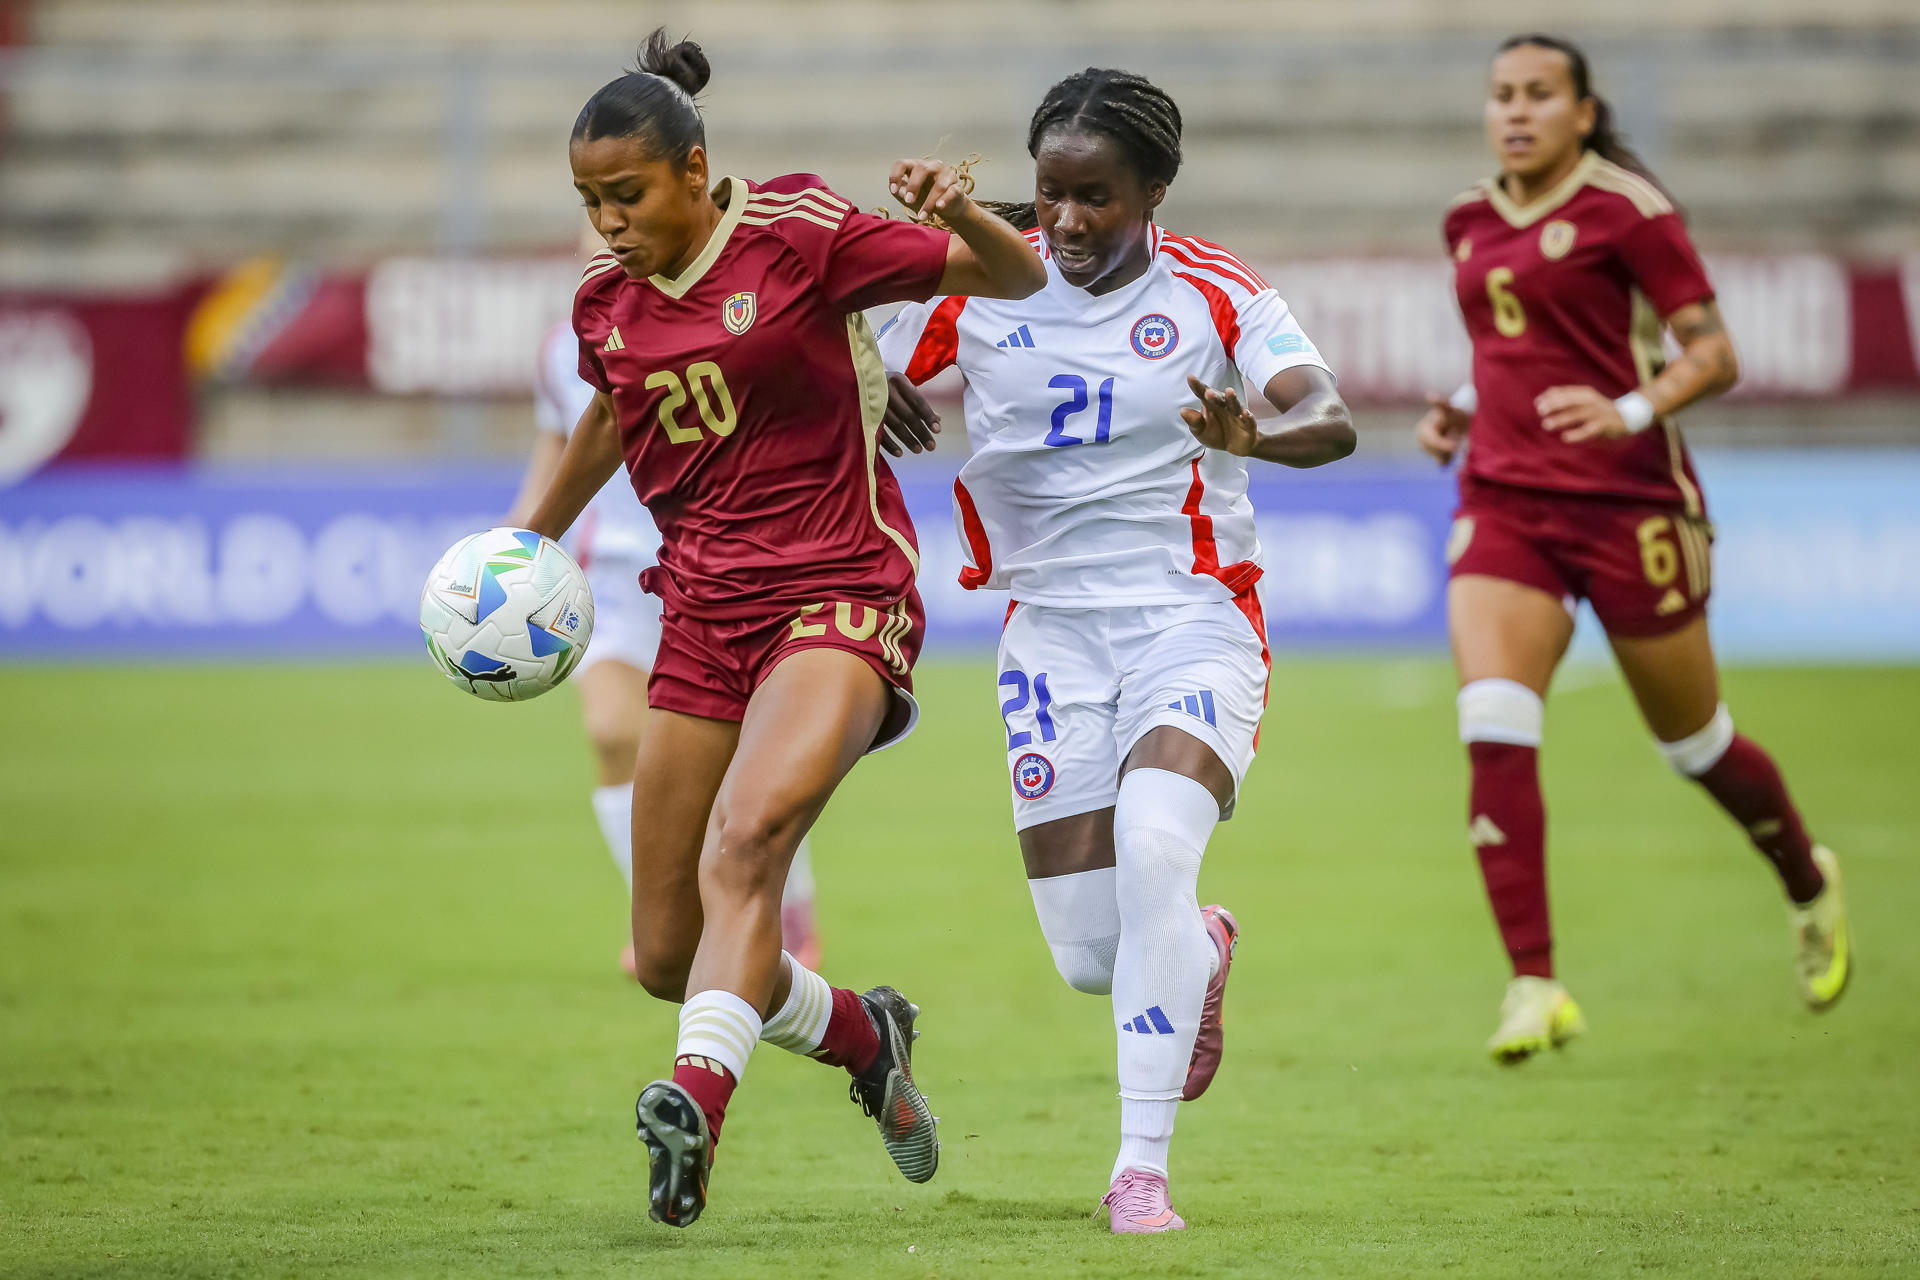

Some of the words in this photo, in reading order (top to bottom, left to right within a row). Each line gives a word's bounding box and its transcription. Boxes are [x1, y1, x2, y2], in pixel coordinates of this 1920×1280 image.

[1485, 266, 1527, 338] 6
[644, 360, 738, 445] 20
[1043, 374, 1115, 448] 21
[1636, 515, 1679, 587] 6
[998, 669, 1057, 752] 21
